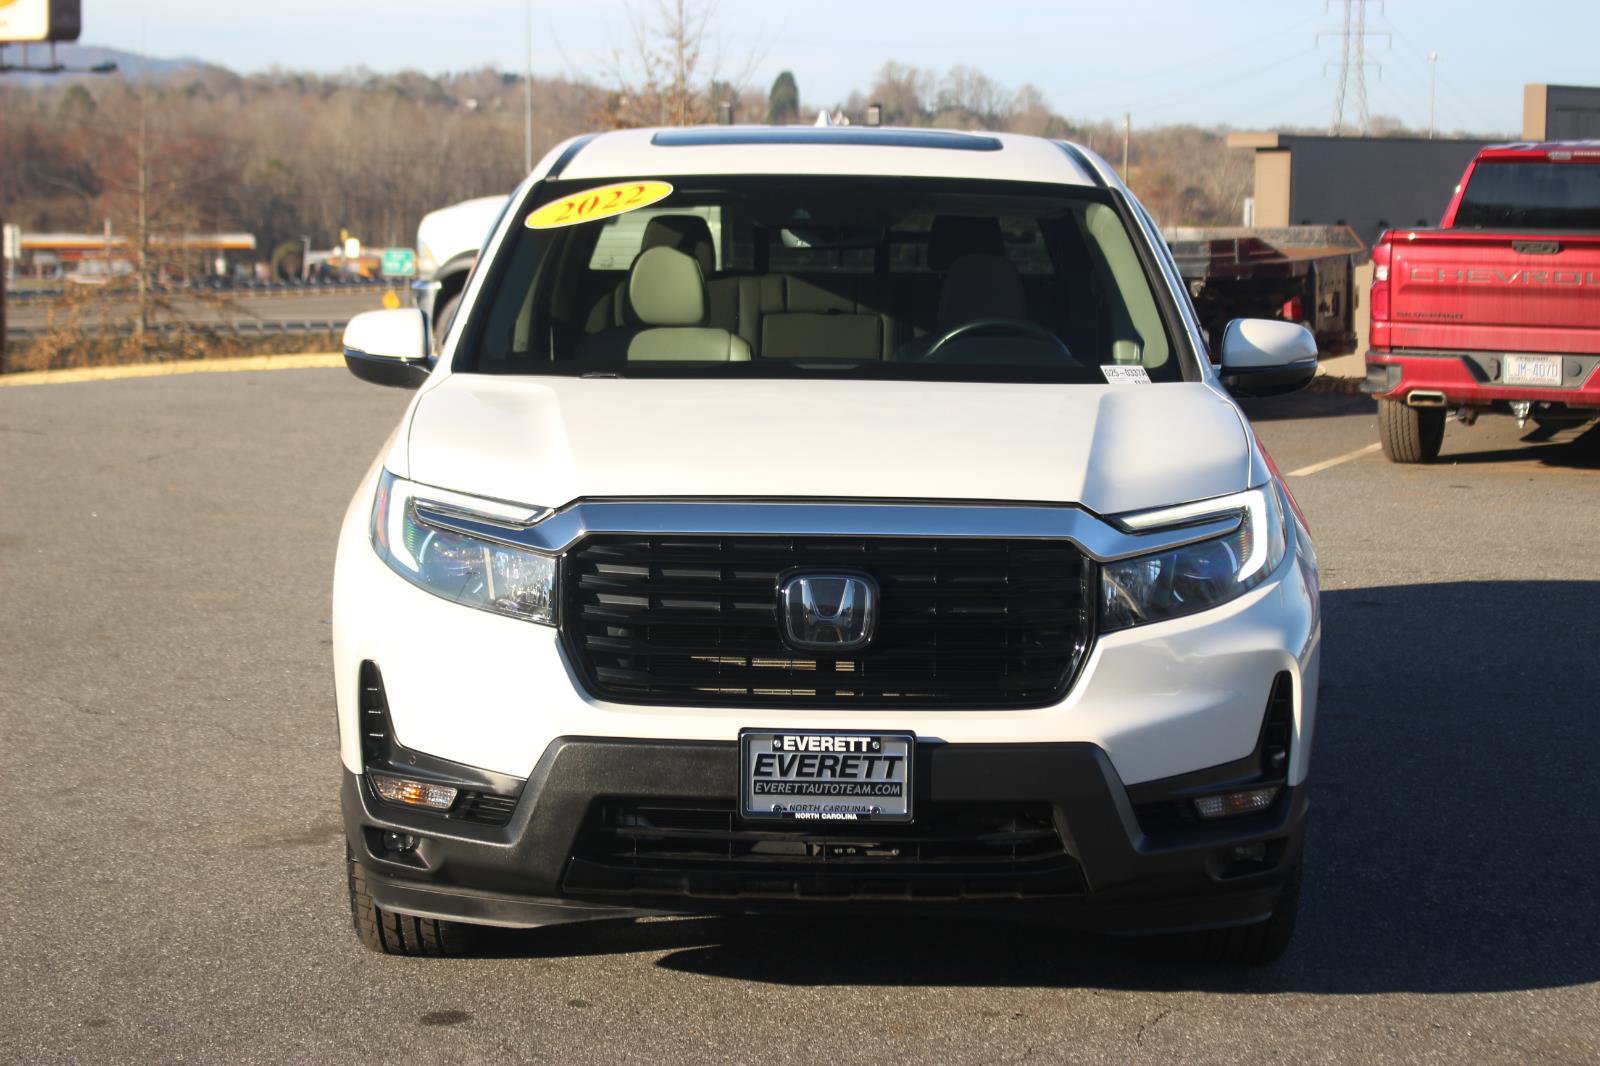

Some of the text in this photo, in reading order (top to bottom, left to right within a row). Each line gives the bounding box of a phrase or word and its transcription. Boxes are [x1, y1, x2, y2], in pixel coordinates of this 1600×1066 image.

[555, 186, 645, 222] 2022
[783, 735, 871, 752] EVERETT
[753, 753, 903, 779] EVERETT
[755, 782, 900, 795] EVERETTAUTOTEAM.COM
[795, 812, 857, 820] NORTH CAROLINA
